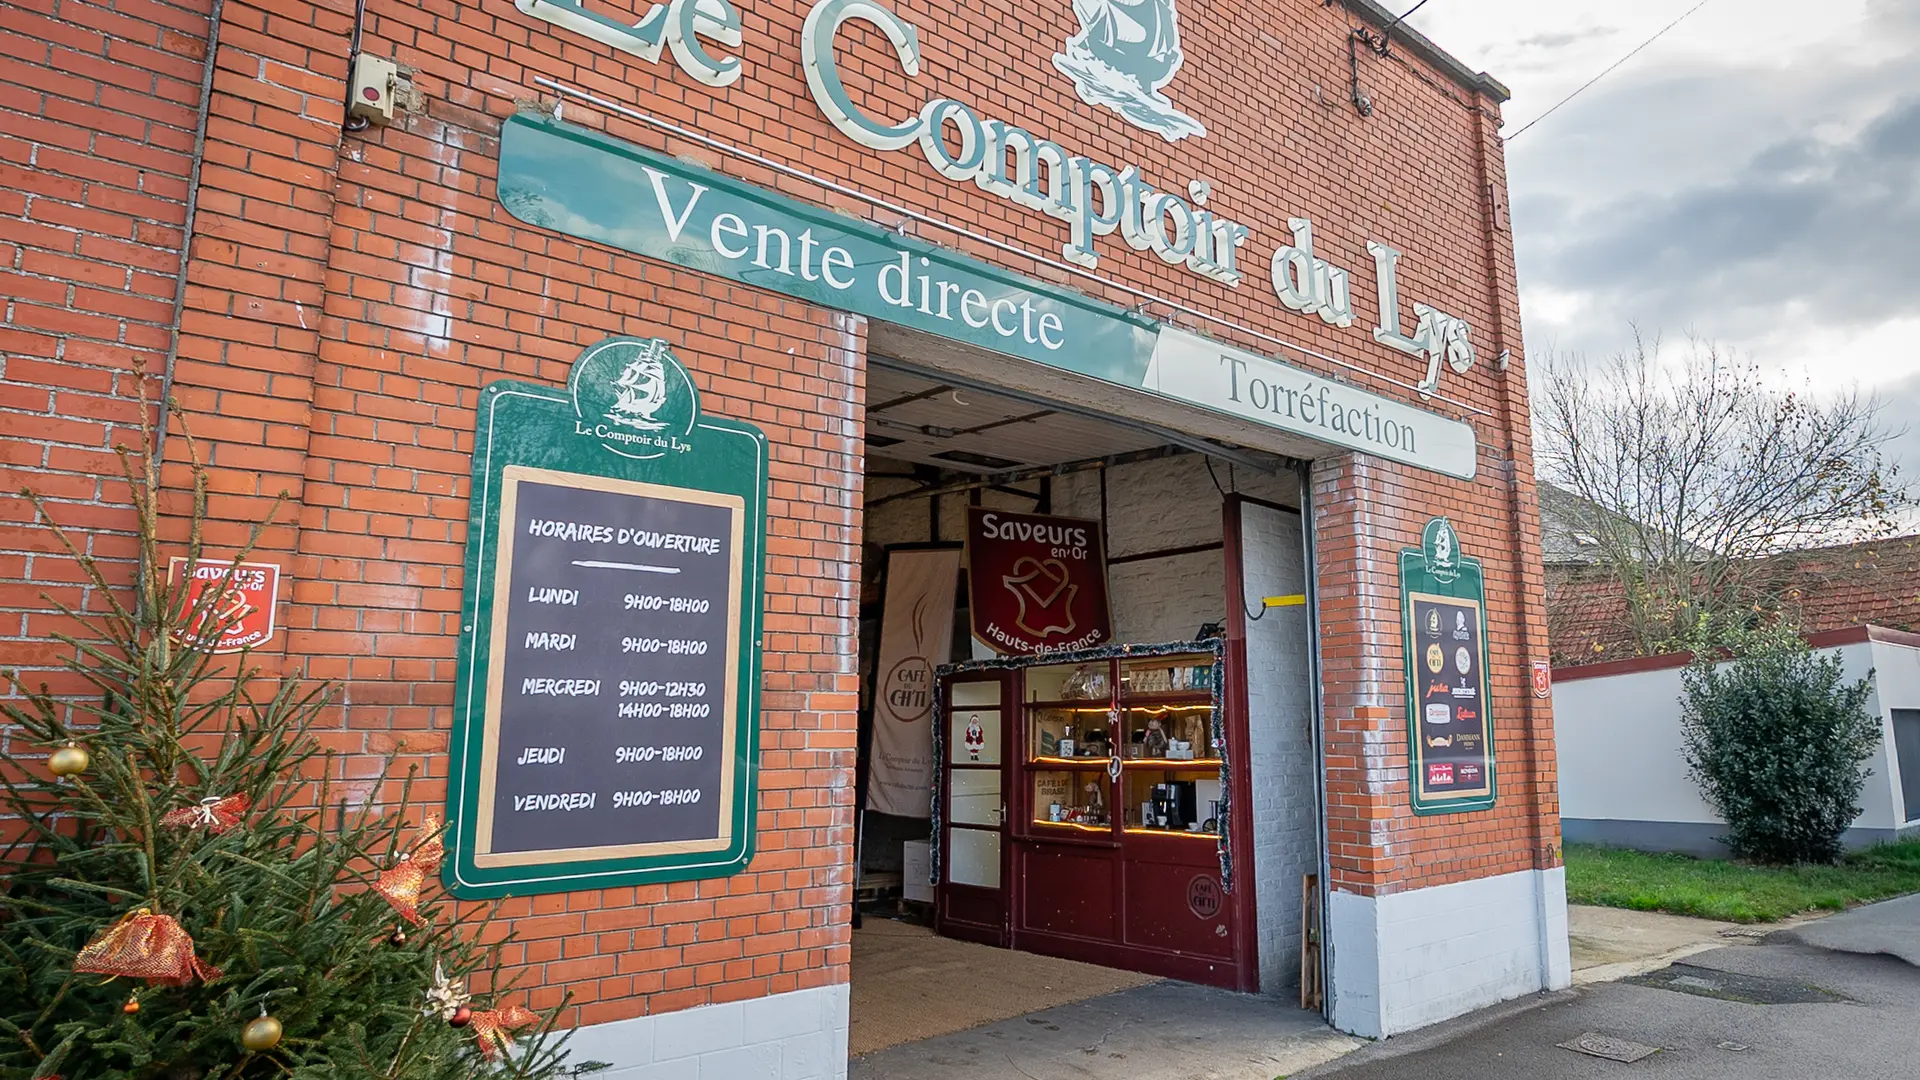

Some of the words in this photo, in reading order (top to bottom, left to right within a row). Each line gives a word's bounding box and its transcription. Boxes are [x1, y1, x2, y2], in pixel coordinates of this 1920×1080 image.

[801, 0, 1249, 288] Comptoir
[1271, 217, 1358, 328] du
[1366, 240, 1475, 401] Lys
[641, 167, 856, 290] Vente
[877, 251, 1065, 351] directe
[1219, 354, 1417, 454] Torréfaction
[575, 420, 592, 437] Le
[595, 424, 652, 447] Comptoir
[654, 434, 669, 448] du
[671, 437, 692, 453] Lys
[528, 518, 613, 544] HORAIRES
[617, 527, 721, 556] D'OUVERTURE
[982, 513, 1087, 547] Saveurs
[528, 586, 580, 606] LUNDI
[623, 594, 710, 614] 9H00-18H00
[524, 632, 576, 651] MARDI
[621, 636, 708, 655] 9H00-18H00
[986, 622, 1102, 655] Hauts-de-France
[521, 678, 601, 696] MERCREDI
[618, 680, 706, 697] 9H00-12H30
[617, 702, 710, 719] 14H00-18H00
[517, 747, 566, 766] JEUDI
[614, 746, 703, 763] 9H00-18H00
[513, 792, 597, 812] VENDREDI
[612, 788, 701, 808] 9H00-18H00
